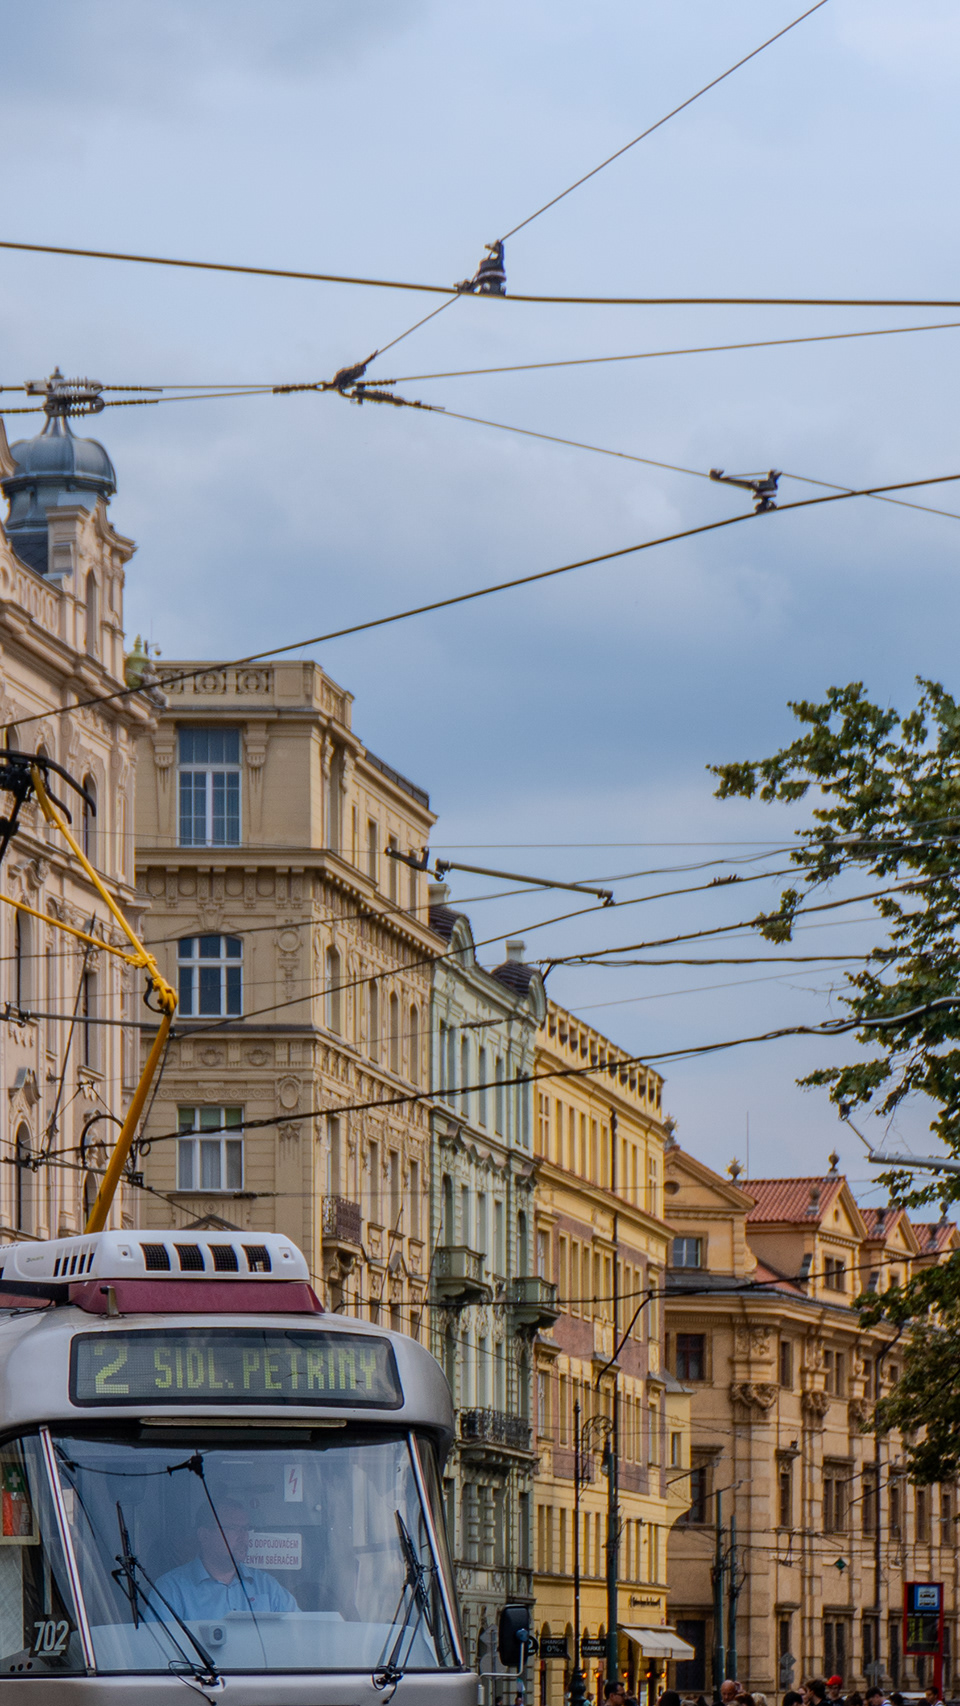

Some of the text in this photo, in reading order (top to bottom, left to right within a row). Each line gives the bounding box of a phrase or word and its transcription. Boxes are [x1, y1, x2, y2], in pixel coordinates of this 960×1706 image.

[94, 1341, 377, 1393] 2 SIDL. PETRINY
[255, 1538, 298, 1548] ODPOJOVAČEM
[266, 1554, 298, 1565] SBĚRAČEM
[33, 1620, 69, 1652] 702
